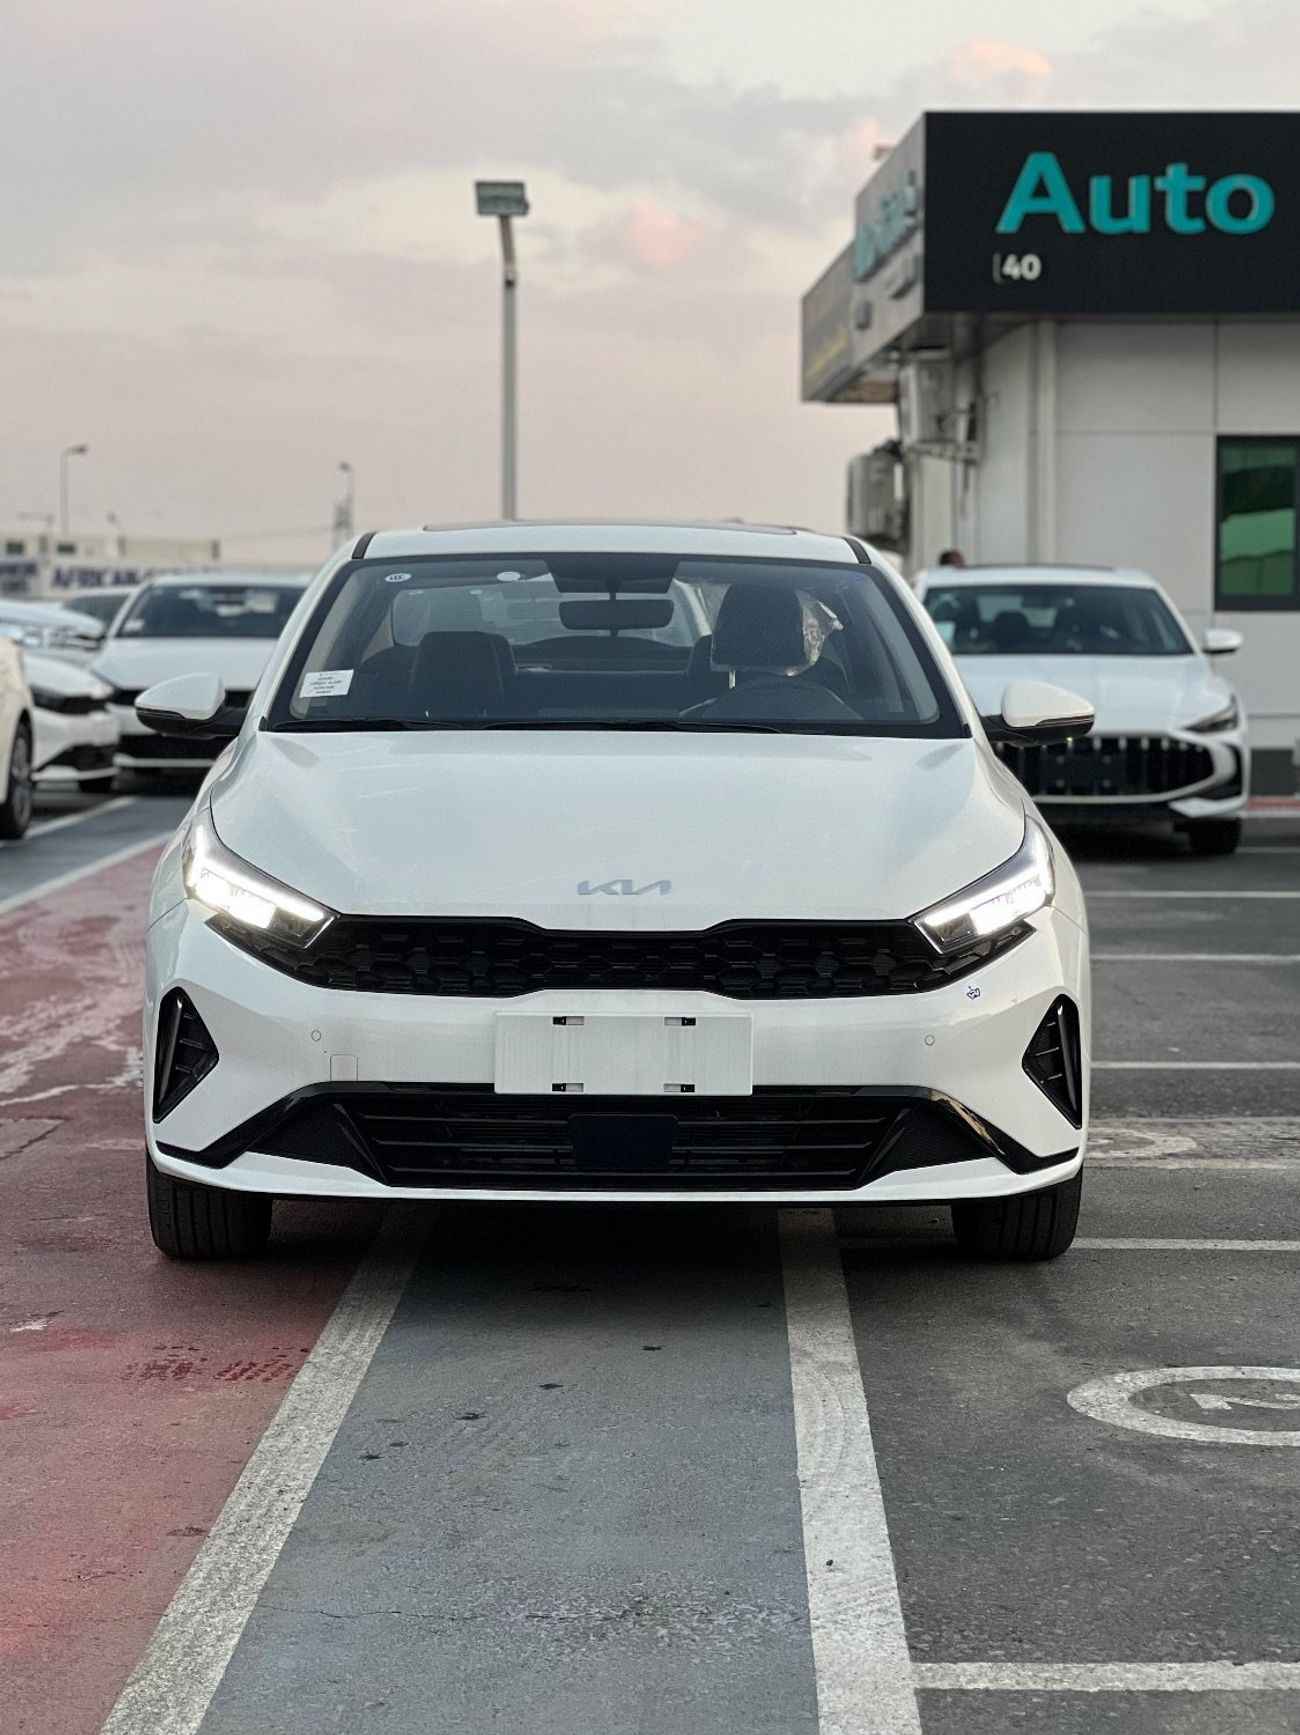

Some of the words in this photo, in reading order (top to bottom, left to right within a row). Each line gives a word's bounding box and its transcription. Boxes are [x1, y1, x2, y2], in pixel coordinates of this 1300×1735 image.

[995, 151, 1276, 235] Auto
[1001, 253, 1042, 281] 40
[577, 879, 672, 896] KIA
